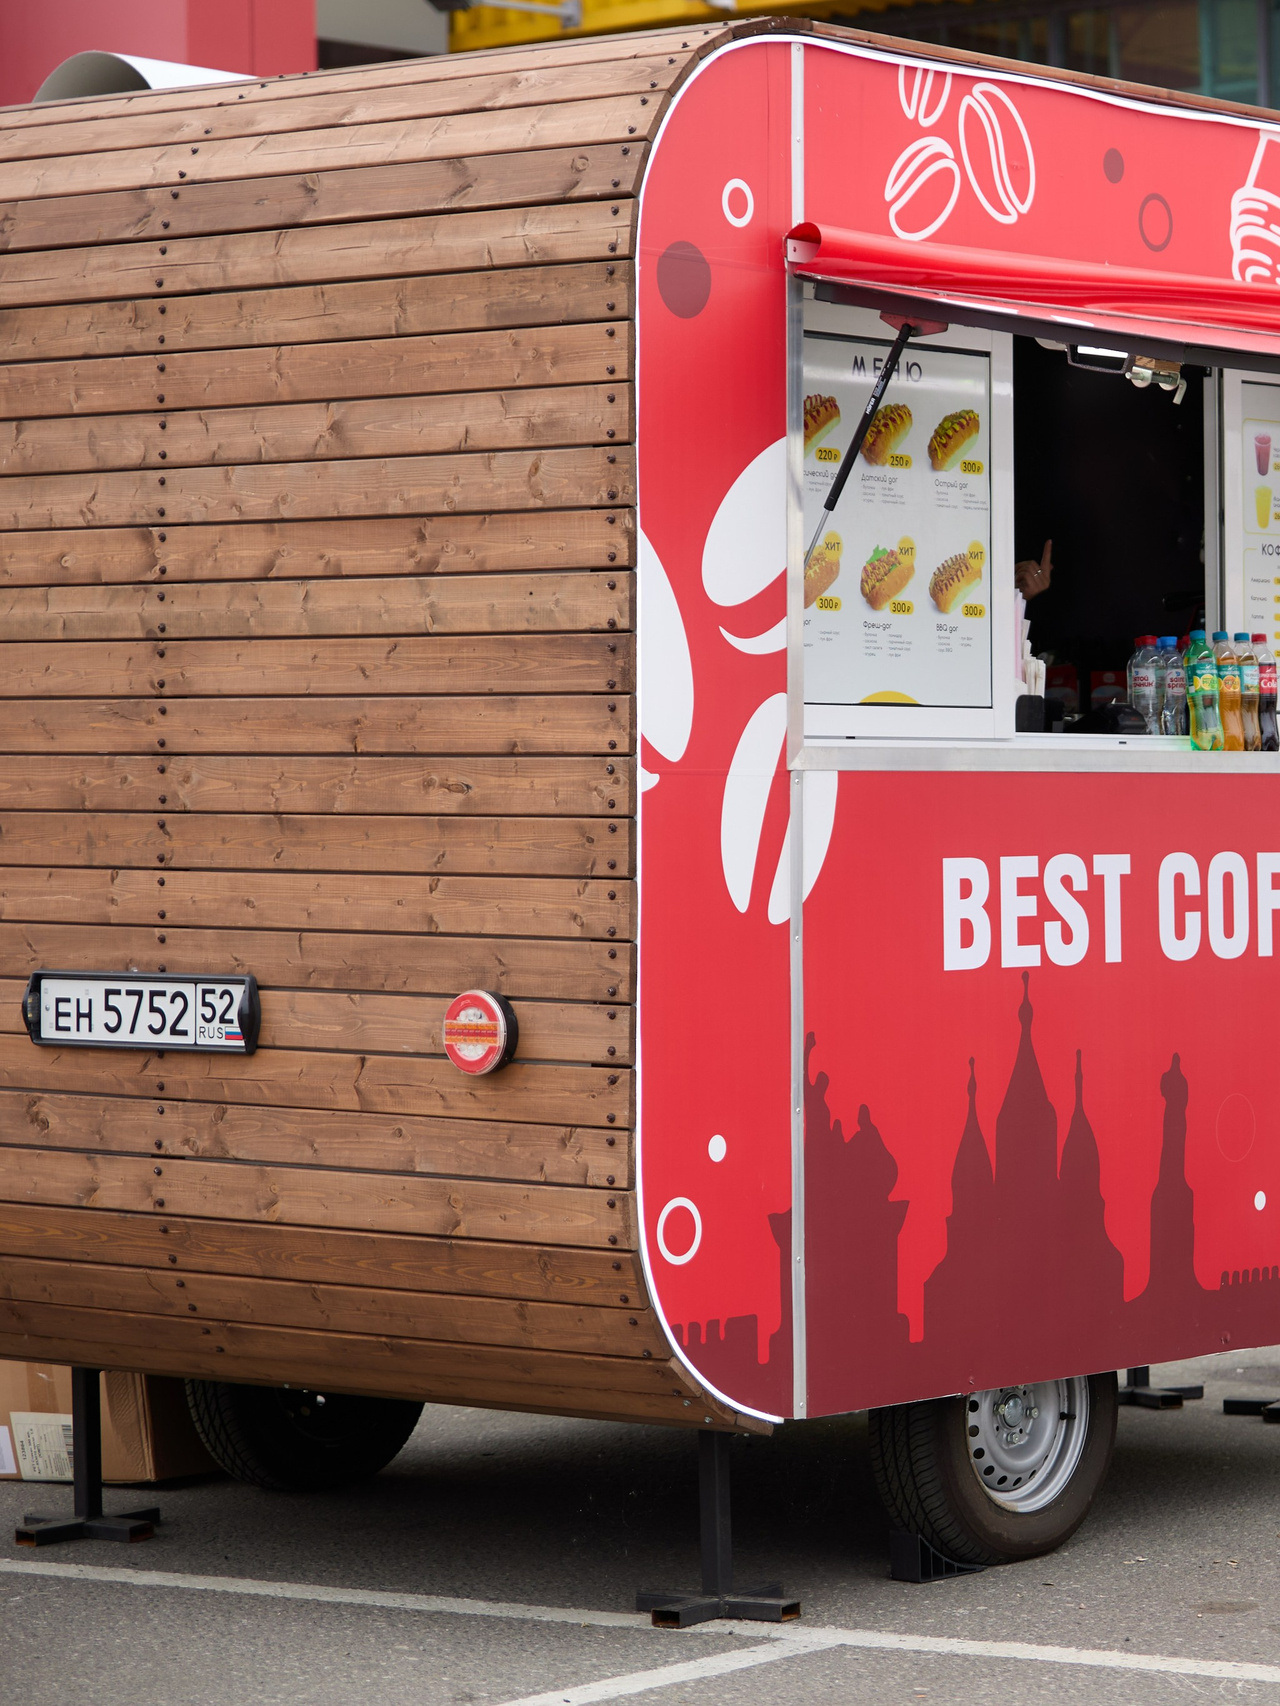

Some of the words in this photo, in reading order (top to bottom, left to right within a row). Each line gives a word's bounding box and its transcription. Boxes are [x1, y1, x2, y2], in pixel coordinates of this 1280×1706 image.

[825, 542, 840, 551] ХИТ
[899, 546, 914, 556] ХИТ
[968, 551, 983, 560] ХИТ
[942, 853, 1131, 971] BEST
[104, 988, 189, 1036] 5752
[200, 988, 234, 1025] 52
[199, 1026, 224, 1039] RUS
